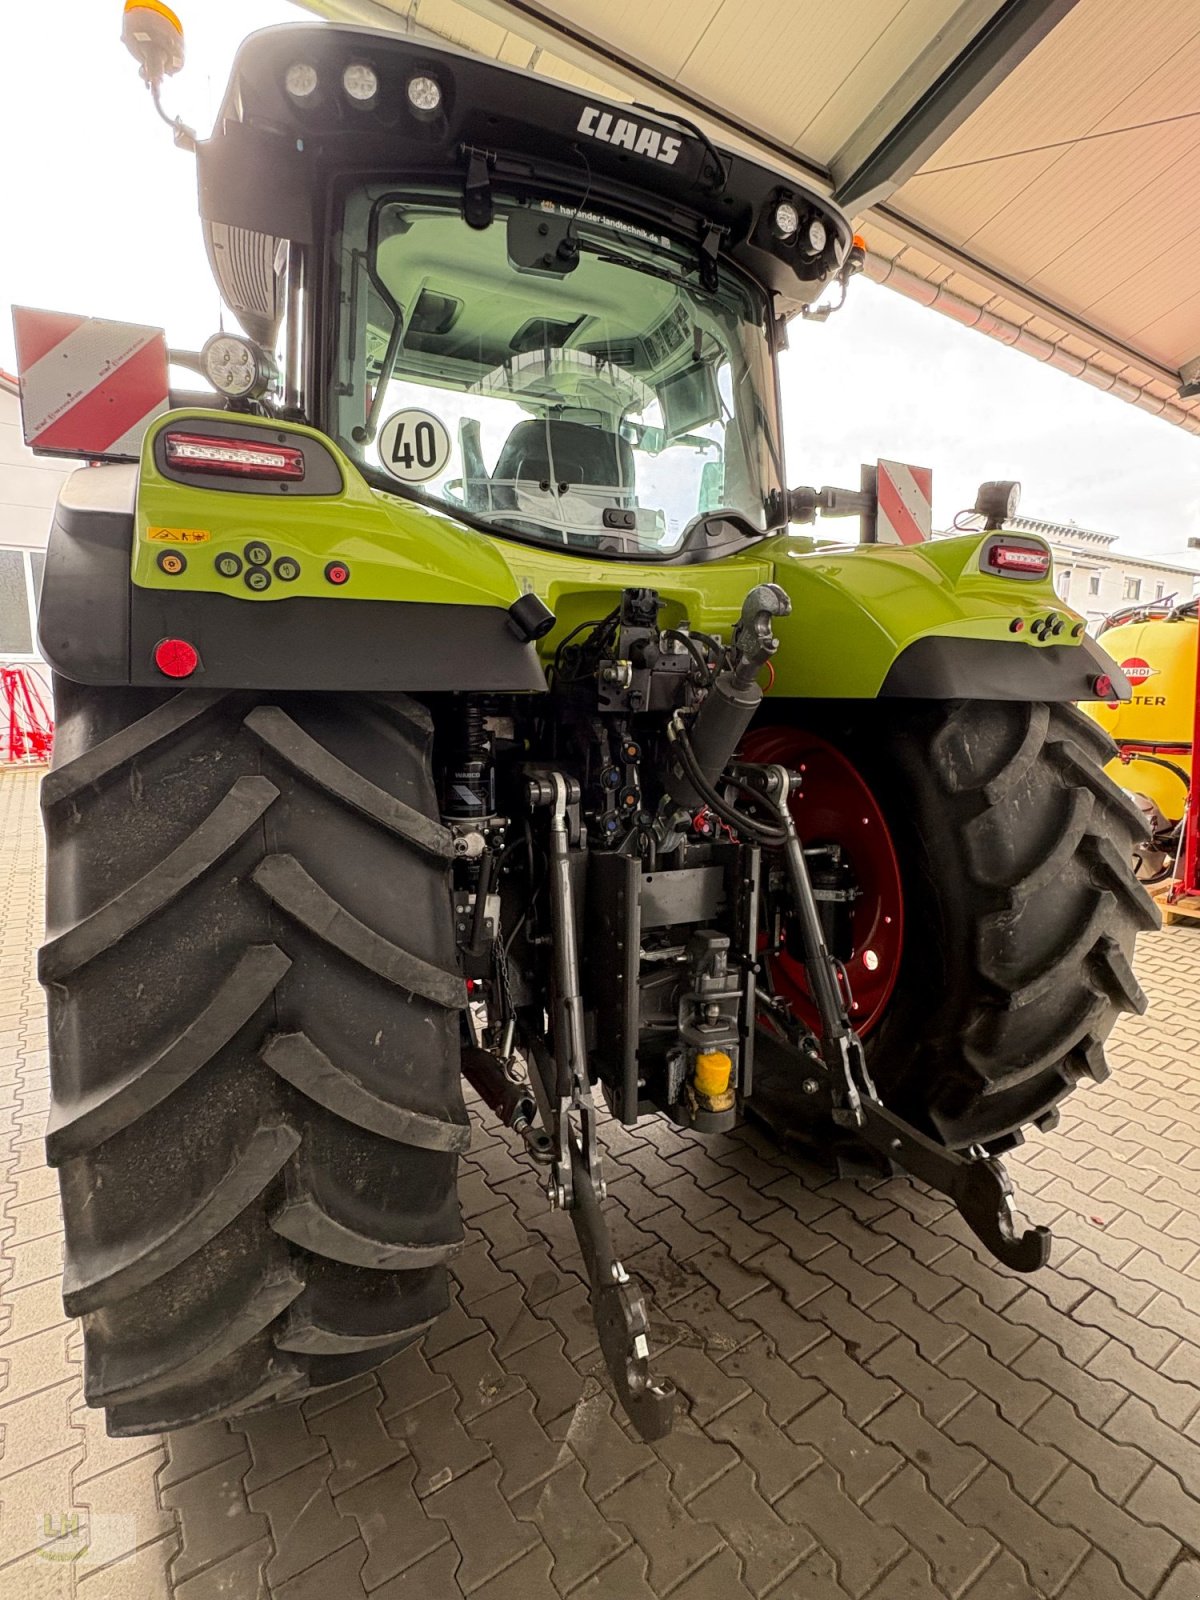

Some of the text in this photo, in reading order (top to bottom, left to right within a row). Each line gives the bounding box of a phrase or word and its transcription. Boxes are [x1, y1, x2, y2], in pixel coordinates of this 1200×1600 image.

[576, 106, 682, 165] CLAAS
[391, 421, 437, 469] 40
[1122, 668, 1151, 676] ARDI
[1119, 695, 1167, 706] STER
